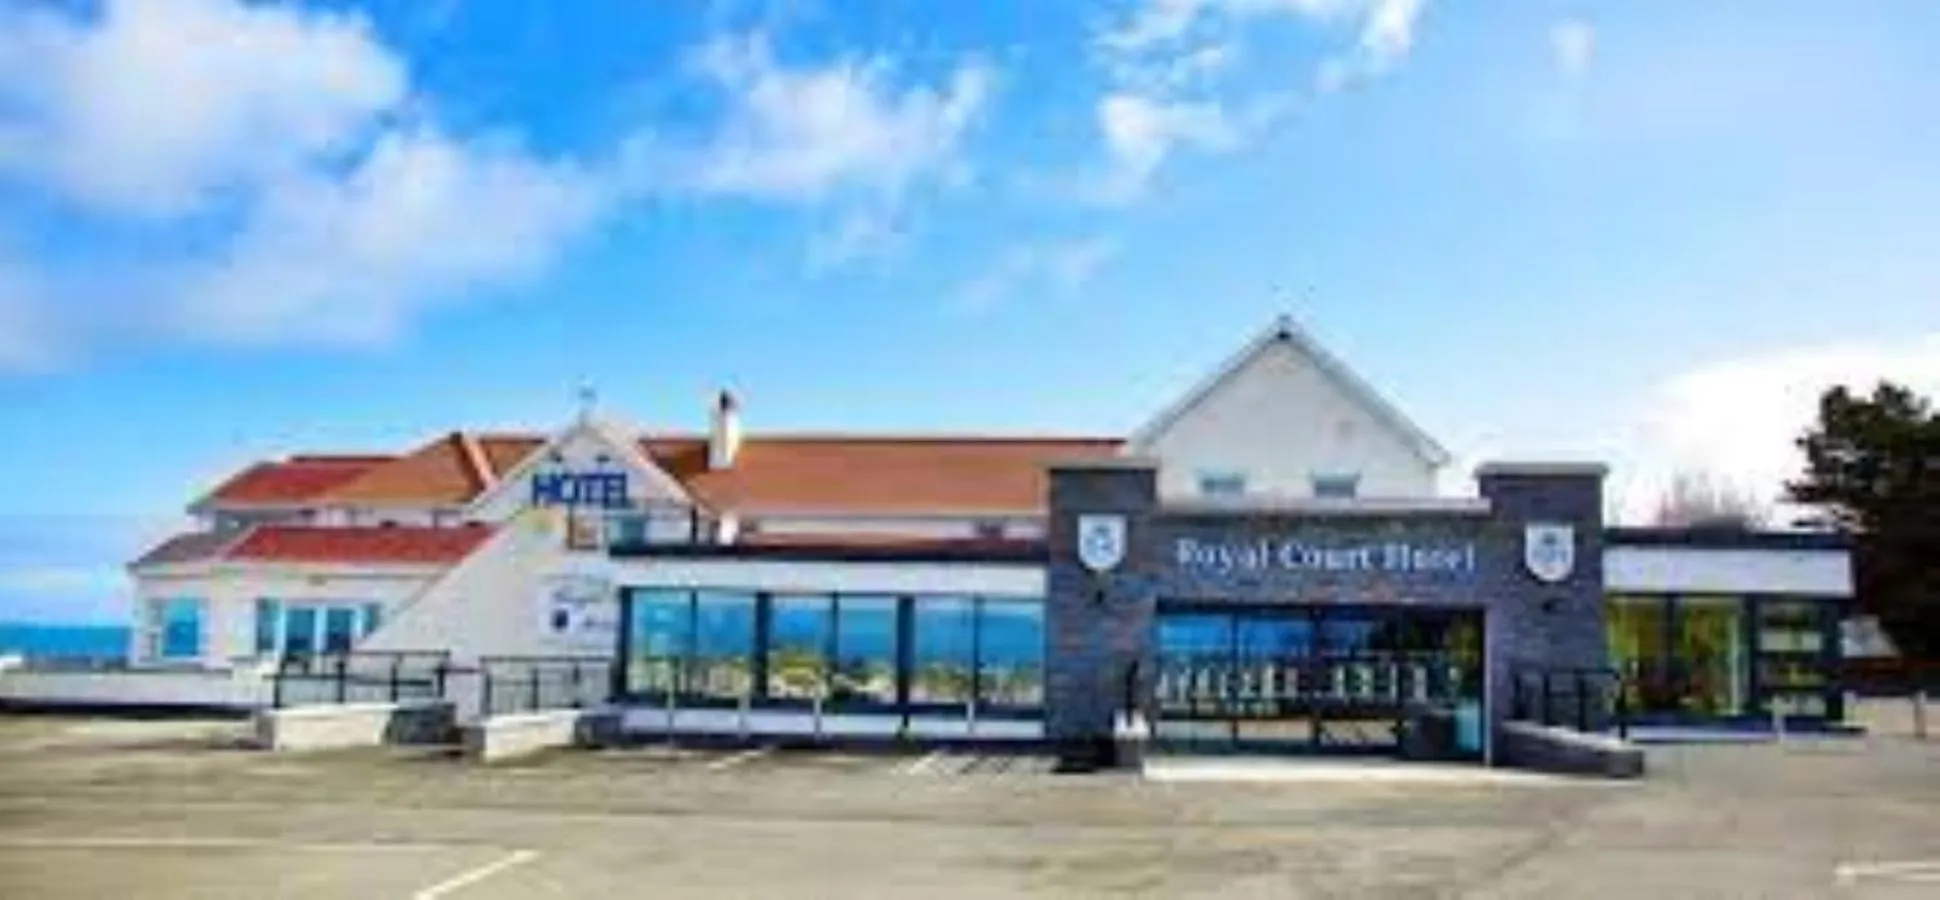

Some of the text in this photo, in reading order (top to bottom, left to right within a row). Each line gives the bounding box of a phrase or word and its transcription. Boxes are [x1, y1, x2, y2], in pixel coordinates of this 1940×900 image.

[531, 472, 631, 509] HOTEL
[1176, 538, 1269, 576] Royal
[1278, 540, 1377, 570] Court
